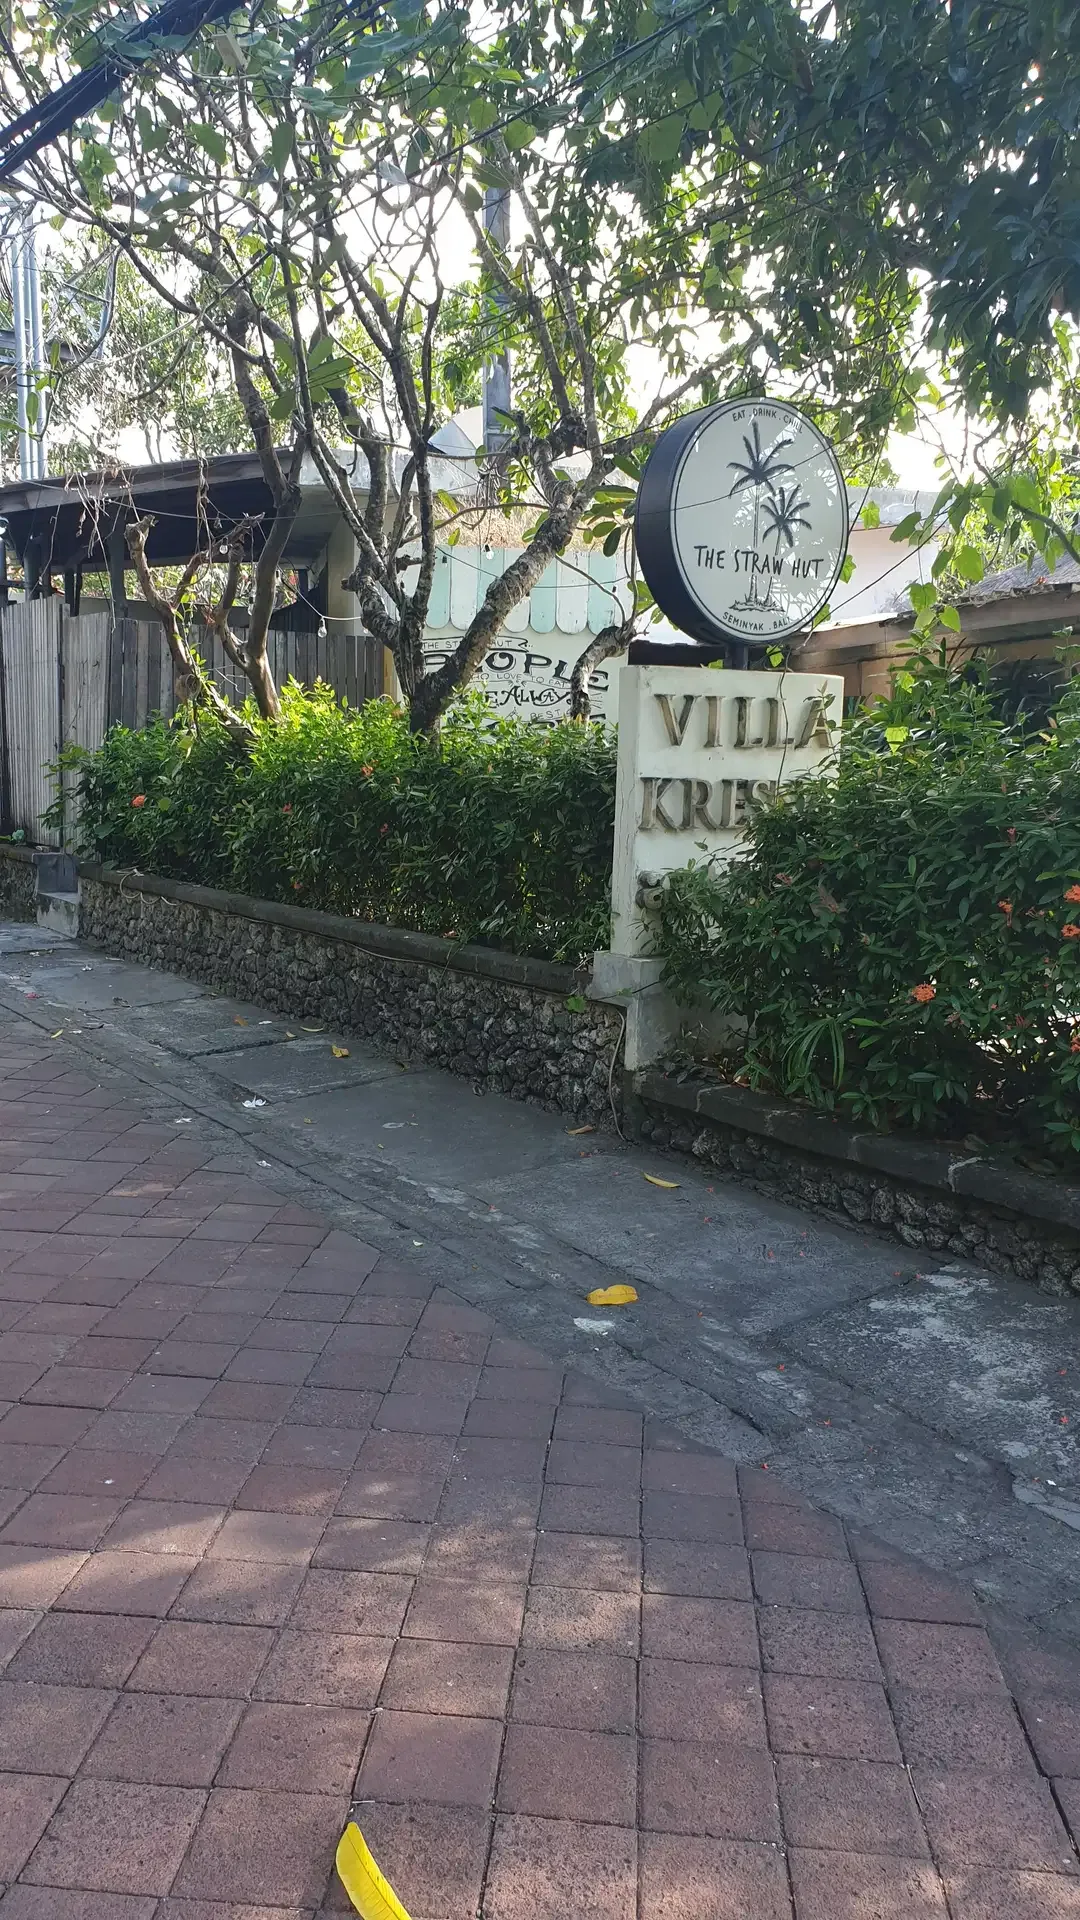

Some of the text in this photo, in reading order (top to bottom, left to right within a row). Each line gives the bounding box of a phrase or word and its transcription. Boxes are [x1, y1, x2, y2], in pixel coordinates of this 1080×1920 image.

[732, 408, 803, 434] EAT DRINK CHILL
[693, 545, 825, 579] THE STRAW HUT
[722, 611, 764, 631] SEMINYAK
[423, 641, 439, 650] THE
[424, 651, 610, 692] POPLE
[653, 693, 833, 750] VILLA
